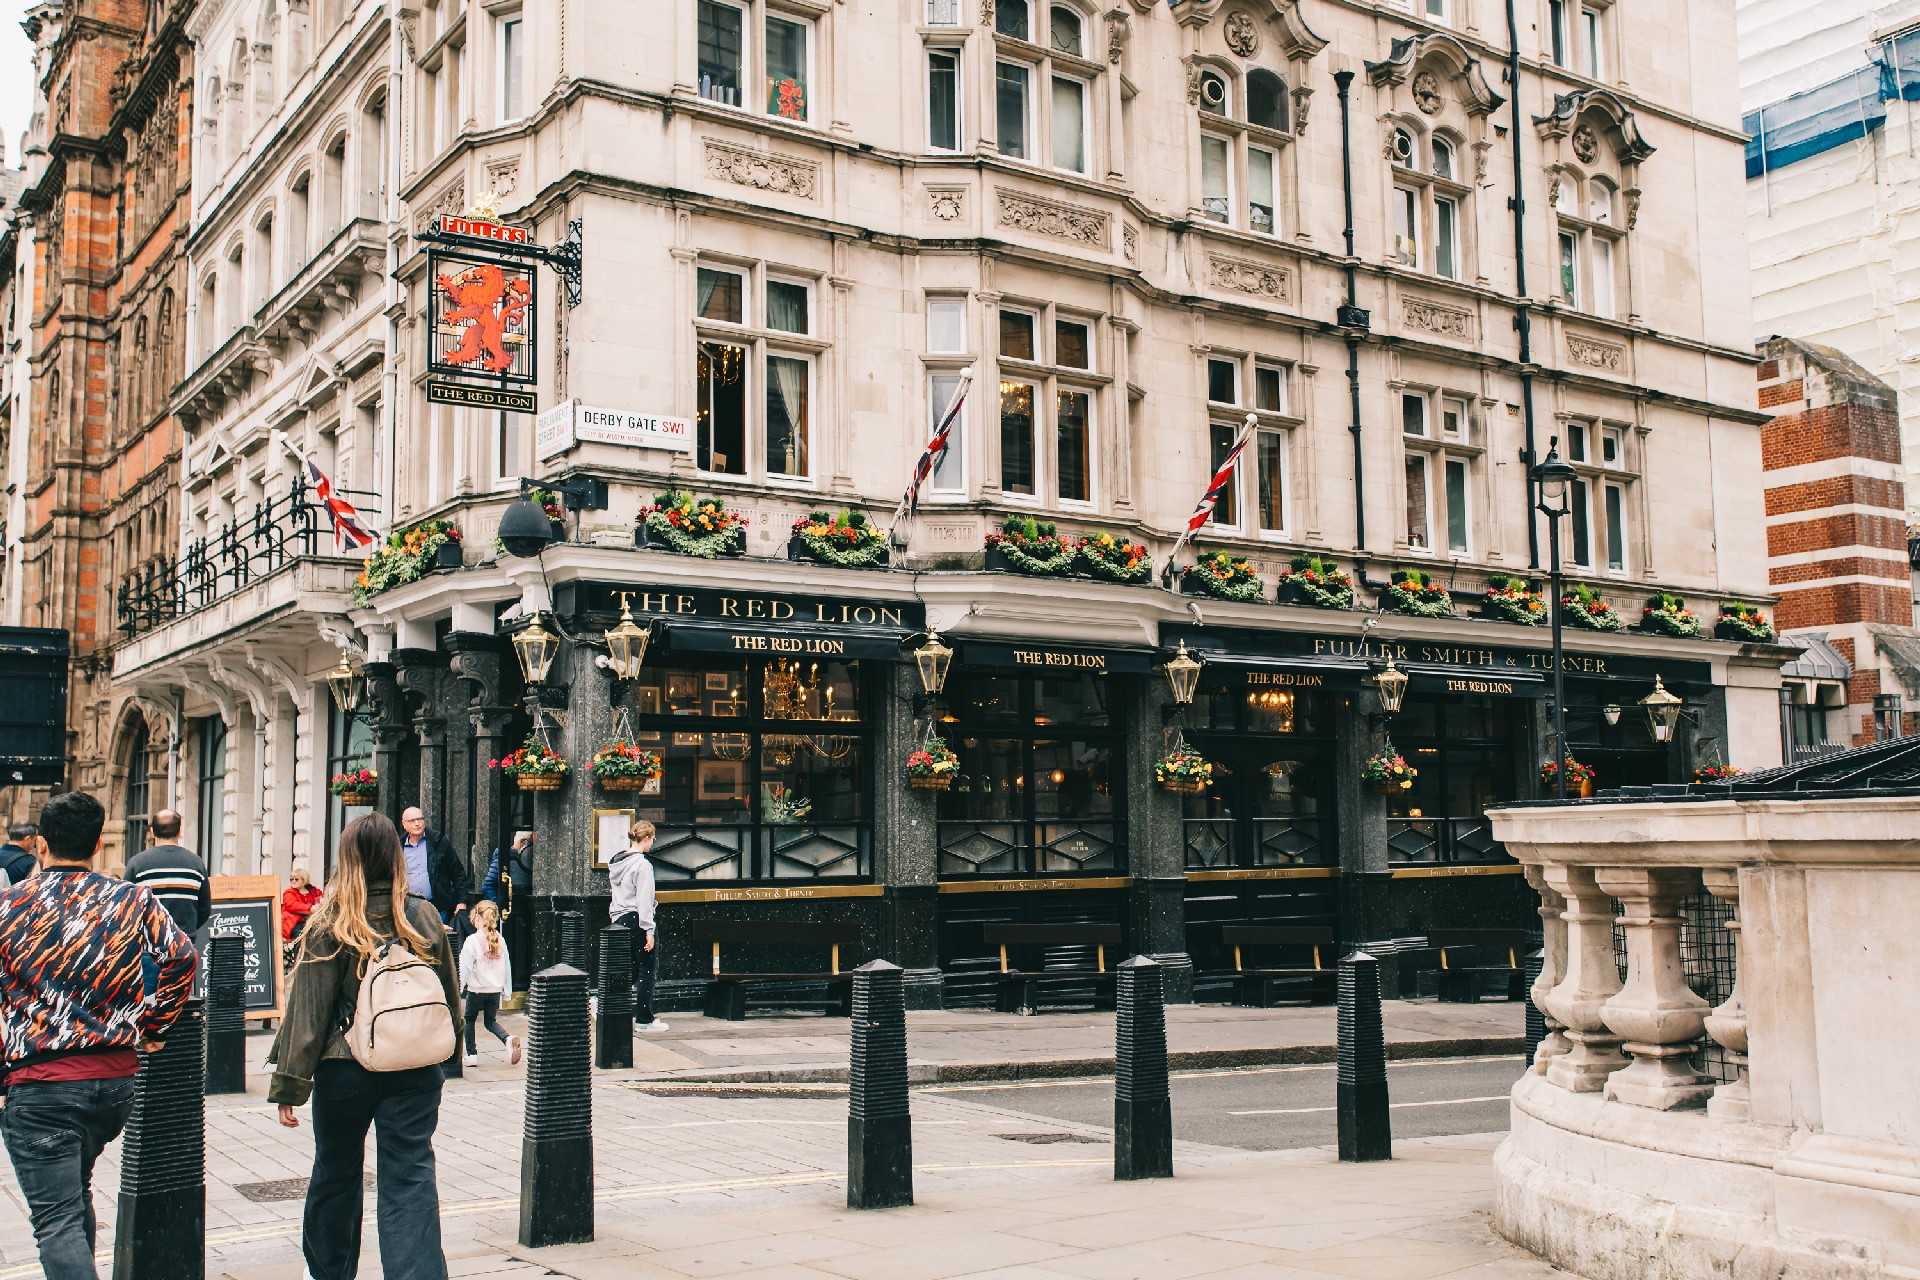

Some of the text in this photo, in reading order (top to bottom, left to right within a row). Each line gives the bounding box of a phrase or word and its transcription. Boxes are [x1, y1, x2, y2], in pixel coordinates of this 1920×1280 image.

[446, 218, 522, 242] FULLER'S
[434, 387, 530, 407] THE RED LION
[584, 411, 684, 434] DERBY GATE SW1
[611, 590, 904, 625] THE RED LION
[732, 635, 844, 653] THE RED LION
[1013, 650, 1105, 668] THE RED LION
[1314, 640, 1607, 673] FULLER SMITH & TURNER
[1247, 671, 1323, 686] THE RED LION
[1446, 680, 1512, 694] THE RED LION
